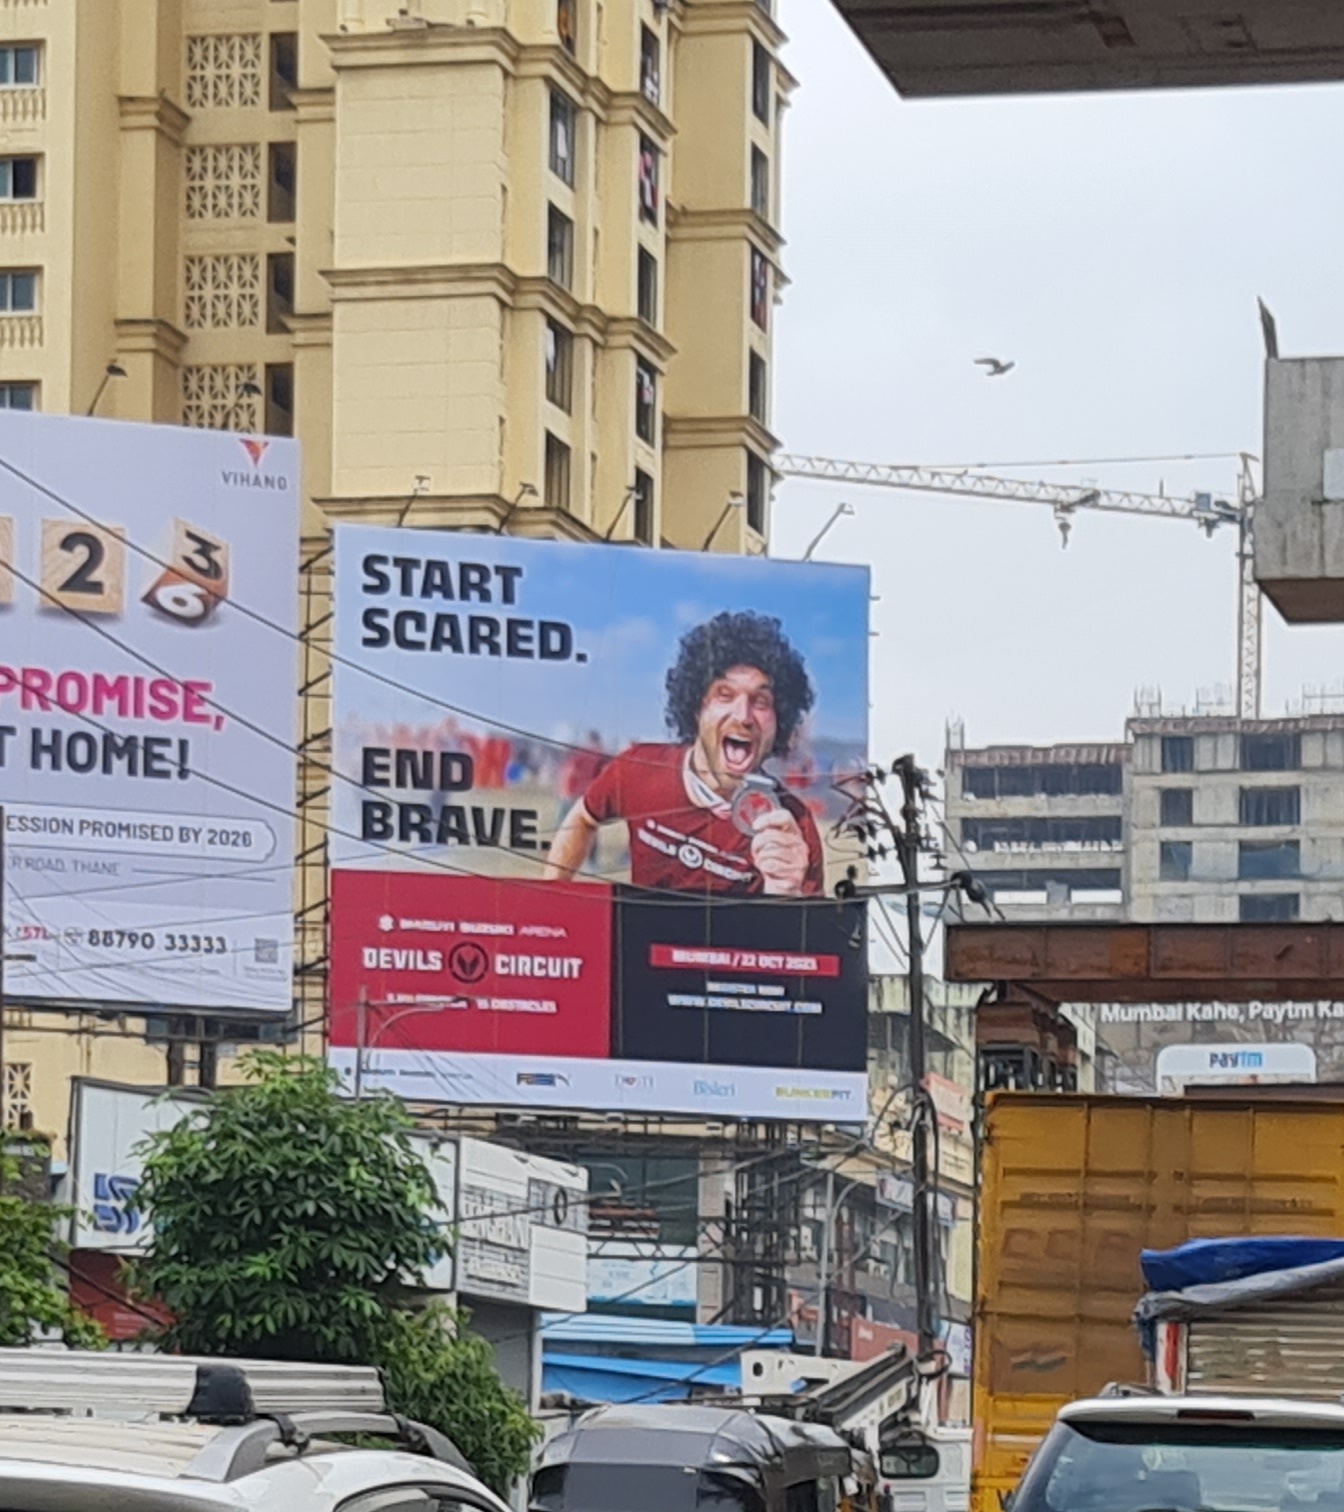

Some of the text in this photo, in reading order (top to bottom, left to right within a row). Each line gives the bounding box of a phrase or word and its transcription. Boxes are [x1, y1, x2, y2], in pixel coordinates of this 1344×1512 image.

[362, 553, 524, 605] START
[362, 607, 589, 663] SCARED.
[29, 727, 191, 780] HOME!
[361, 746, 474, 792] END
[79, 819, 174, 842] PROMISED
[179, 827, 202, 844] BY
[207, 829, 253, 848] 2026
[361, 800, 552, 851] BRAVE.
[72, 859, 120, 876] THANE
[88, 929, 155, 950] 88790
[164, 934, 227, 955] 33333
[362, 946, 584, 979] DEVILS CIRCUIT
[1100, 1001, 1183, 1022] Mumbai
[1186, 1001, 1245, 1024] Kahe,
[1249, 1000, 1315, 1024] Paytm
